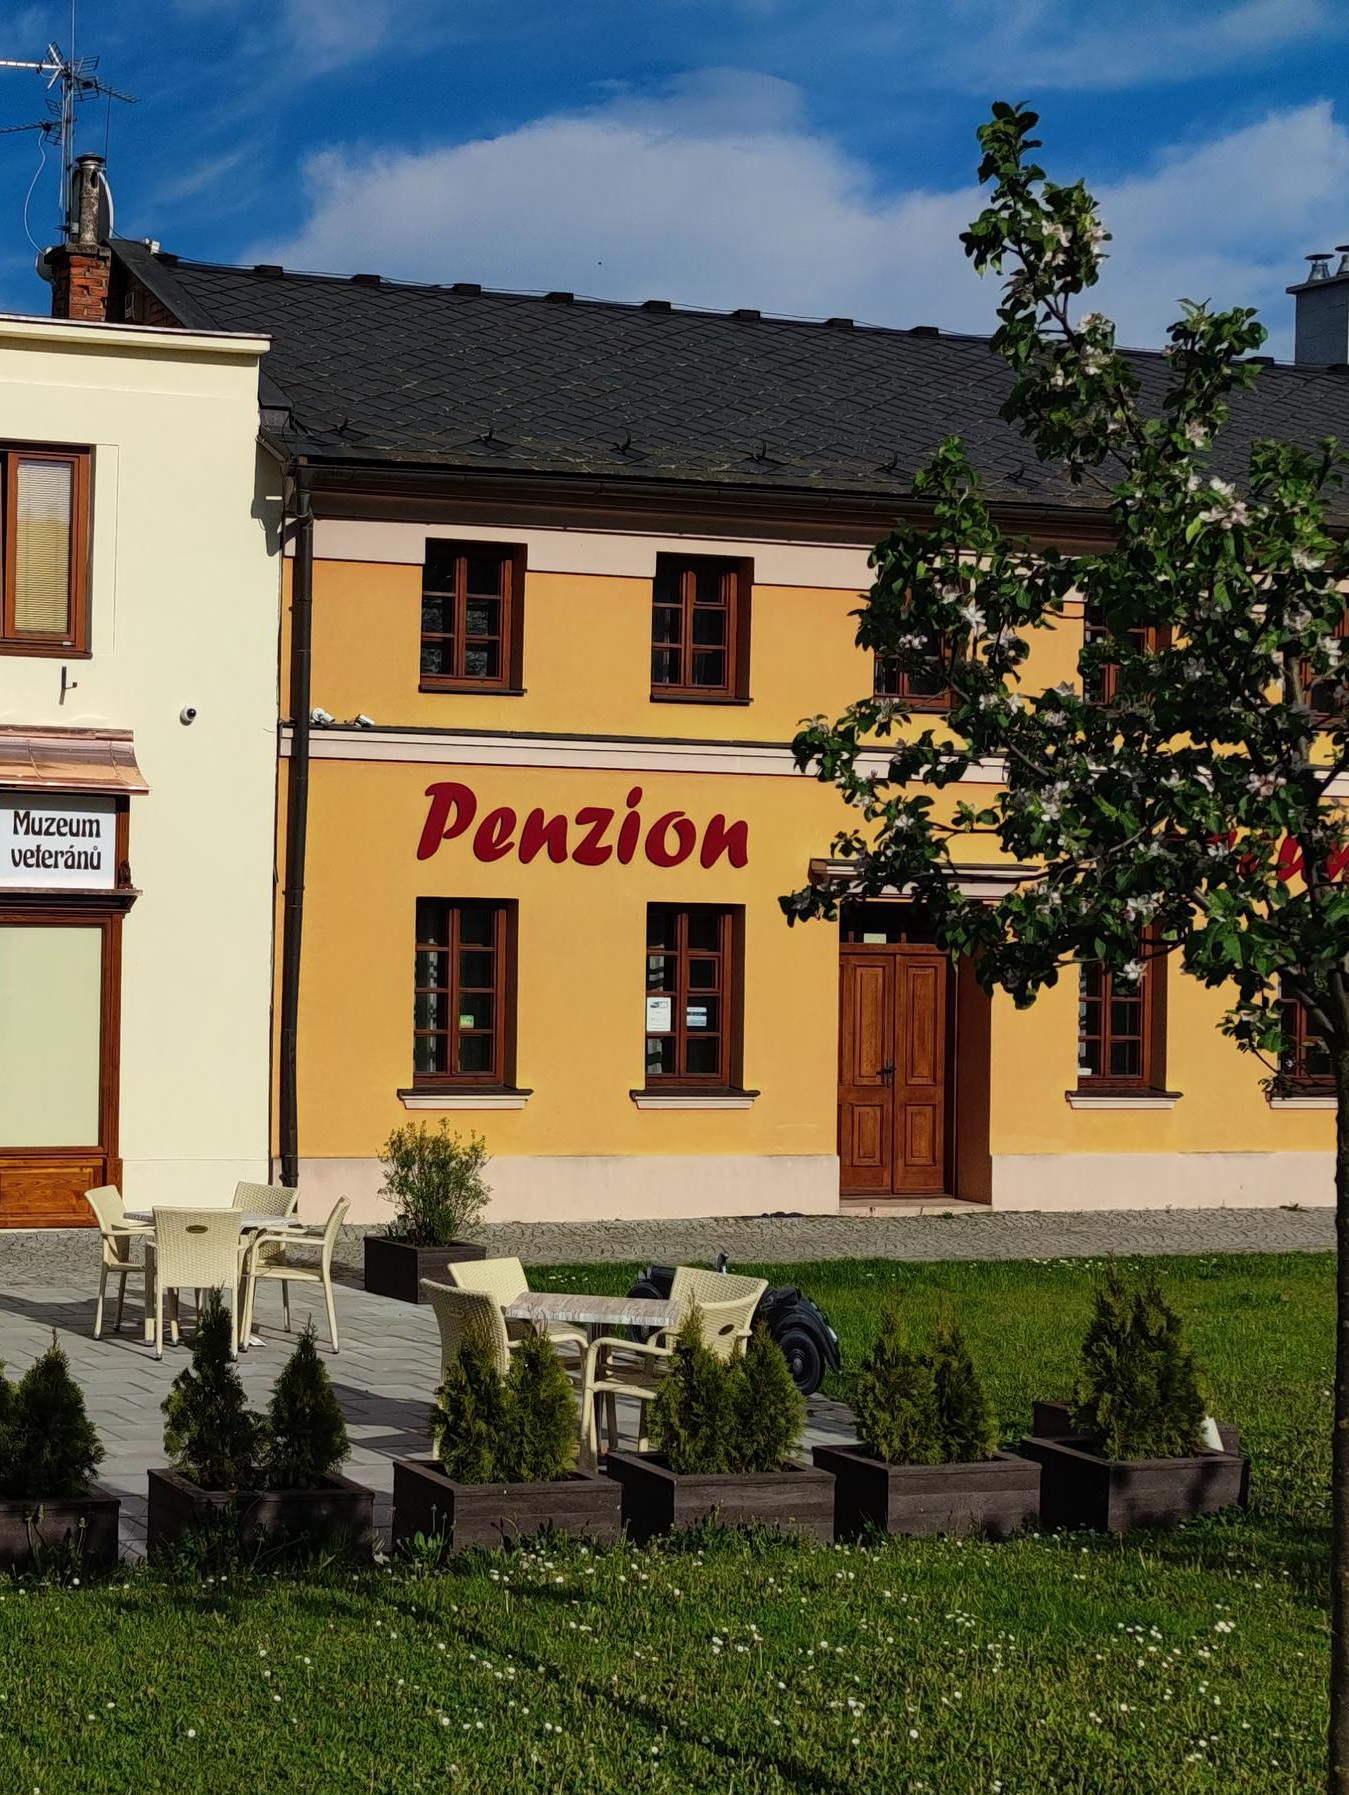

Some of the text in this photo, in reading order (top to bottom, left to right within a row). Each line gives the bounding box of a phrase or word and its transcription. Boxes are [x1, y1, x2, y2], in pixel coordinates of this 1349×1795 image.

[13, 810, 101, 838] Muzeum
[416, 781, 749, 869] Penzion
[11, 844, 102, 871] veteránů
